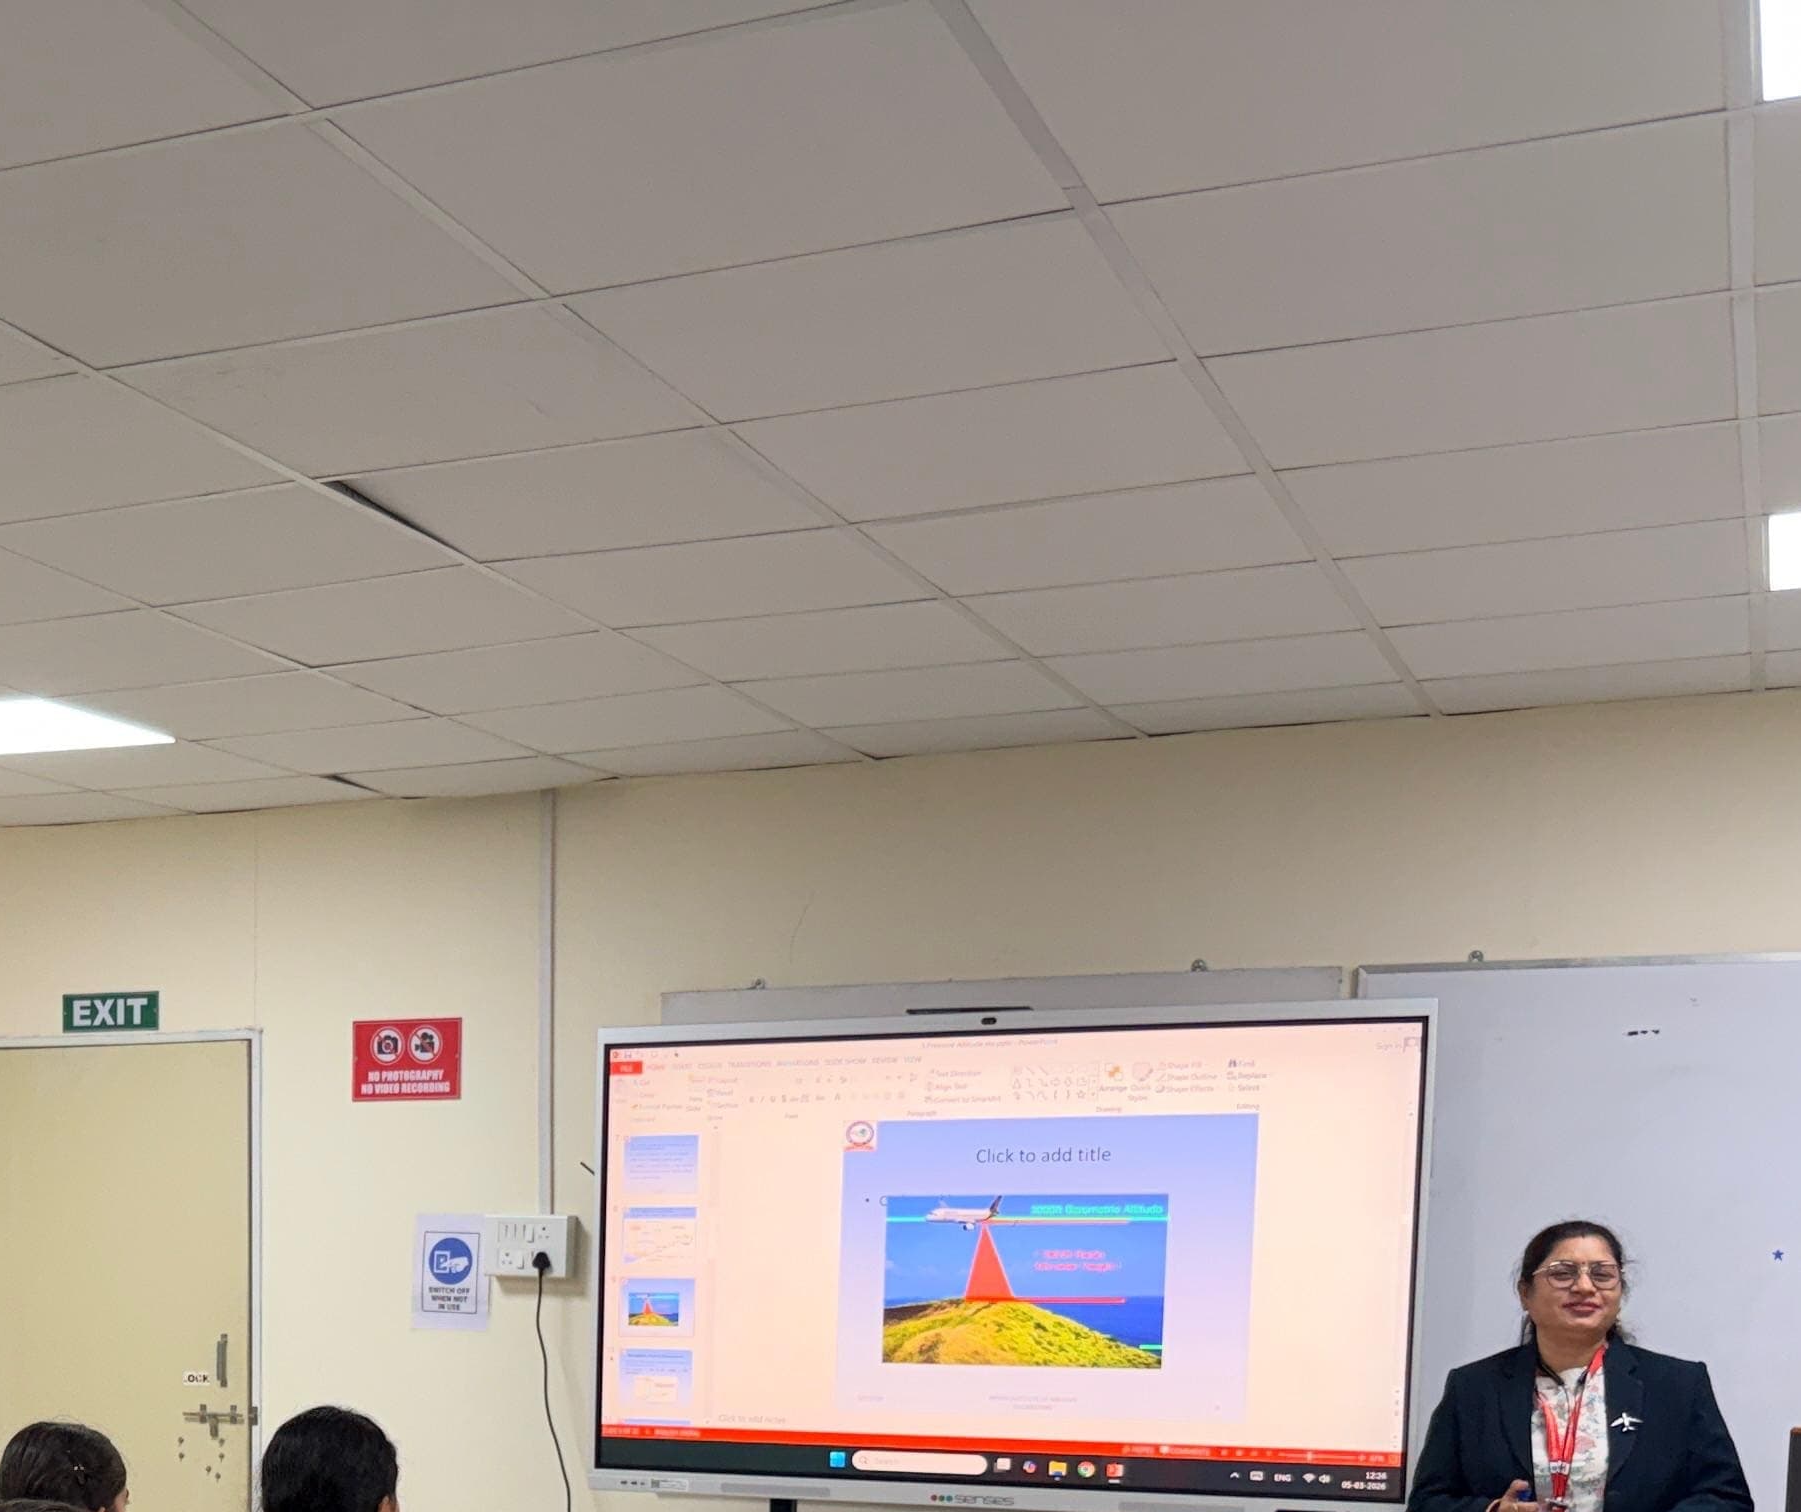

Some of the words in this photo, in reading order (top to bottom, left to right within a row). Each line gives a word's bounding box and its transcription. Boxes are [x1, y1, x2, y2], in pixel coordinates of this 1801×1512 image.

[72, 997, 148, 1027] EXIT
[368, 1071, 381, 1082] NO
[382, 1069, 444, 1082] PHOTOGRAPHY
[361, 1083, 374, 1095] NO
[374, 1083, 400, 1094] VIDEO
[401, 1081, 451, 1094] RECORDING
[976, 1148, 1014, 1163] Click
[1019, 1148, 1036, 1163] to
[1041, 1147, 1072, 1162] add
[1078, 1147, 1112, 1162] title
[429, 1286, 455, 1294] SWITCH
[453, 1295, 468, 1303] NOT
[447, 1303, 461, 1311] USE
[183, 1374, 210, 1383] OCK
[1274, 1473, 1292, 1483] ENG
